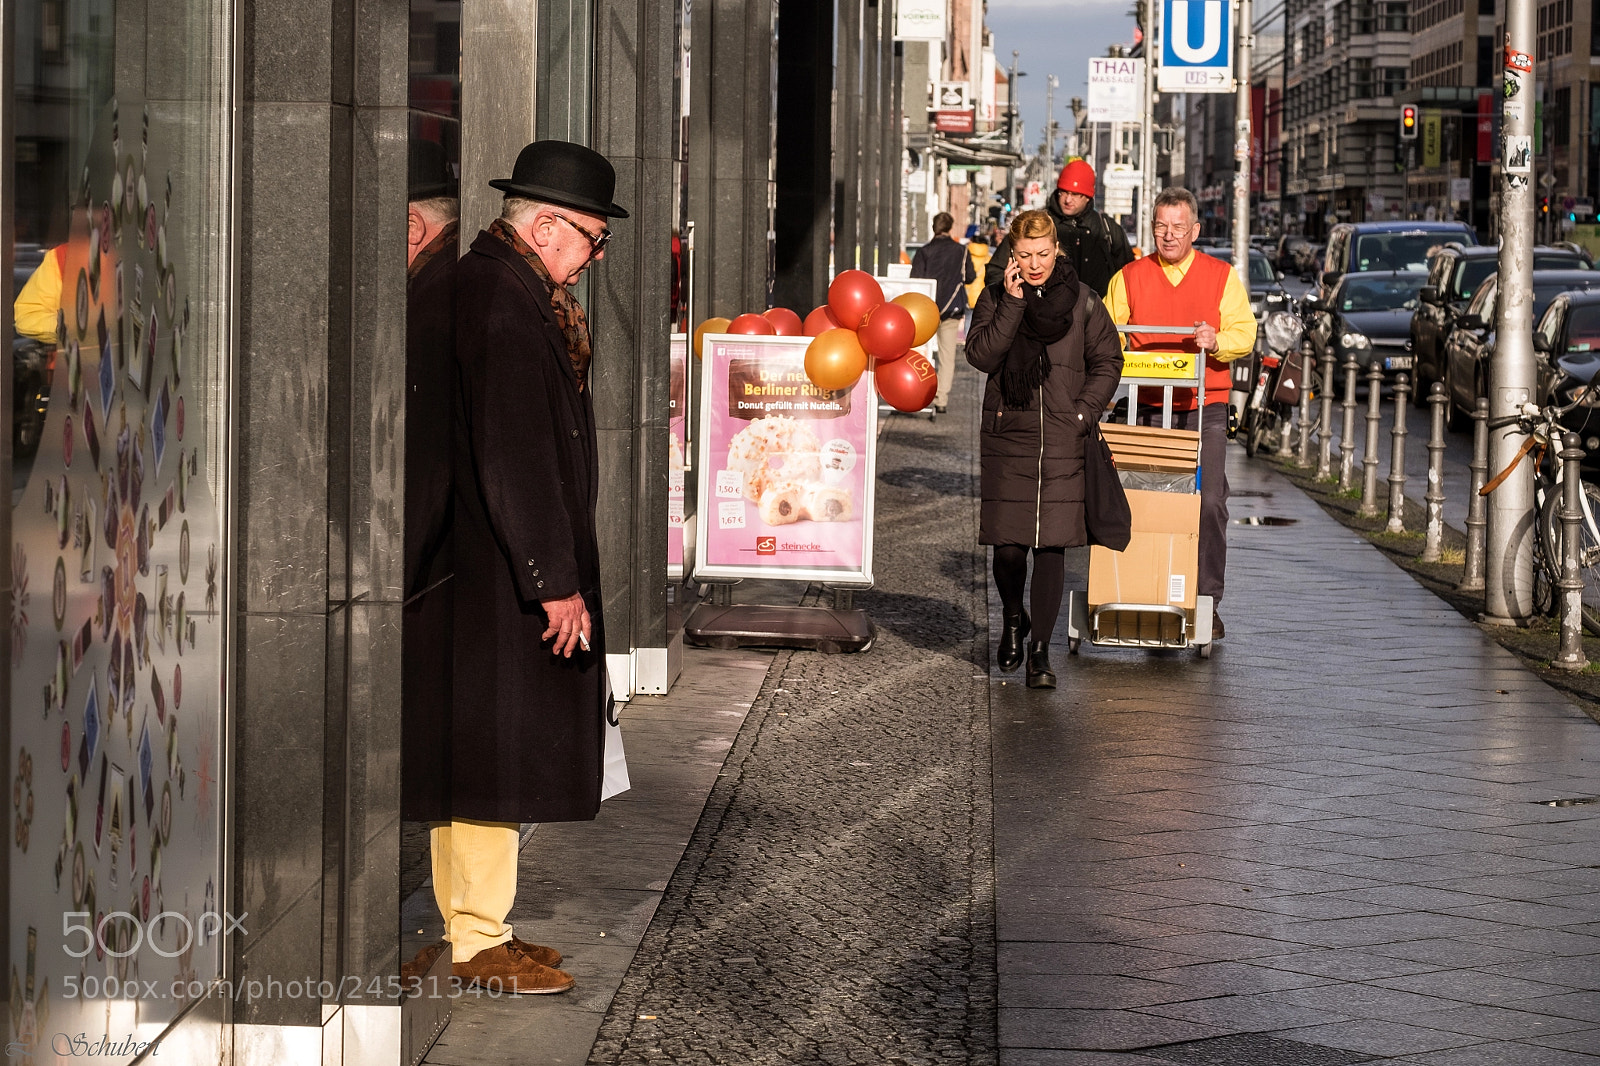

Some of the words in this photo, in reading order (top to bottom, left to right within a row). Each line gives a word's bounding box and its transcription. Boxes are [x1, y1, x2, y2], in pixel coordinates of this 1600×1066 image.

[1171, 0, 1221, 64] U
[1093, 61, 1135, 74] THAI
[1186, 71, 1207, 84] U6
[1123, 361, 1152, 369] utsche
[1153, 361, 1170, 369] Post
[759, 370, 782, 382] Der
[744, 383, 798, 396] Berliner
[738, 401, 764, 409] Donut
[765, 401, 792, 411] gefüllt
[794, 402, 809, 410] mit
[810, 403, 843, 411] Nutella.
[718, 485, 734, 493] 1,50
[735, 486, 740, 494] €
[721, 516, 737, 525] 1,67
[738, 516, 743, 524] €
[781, 542, 821, 551] steinecke
